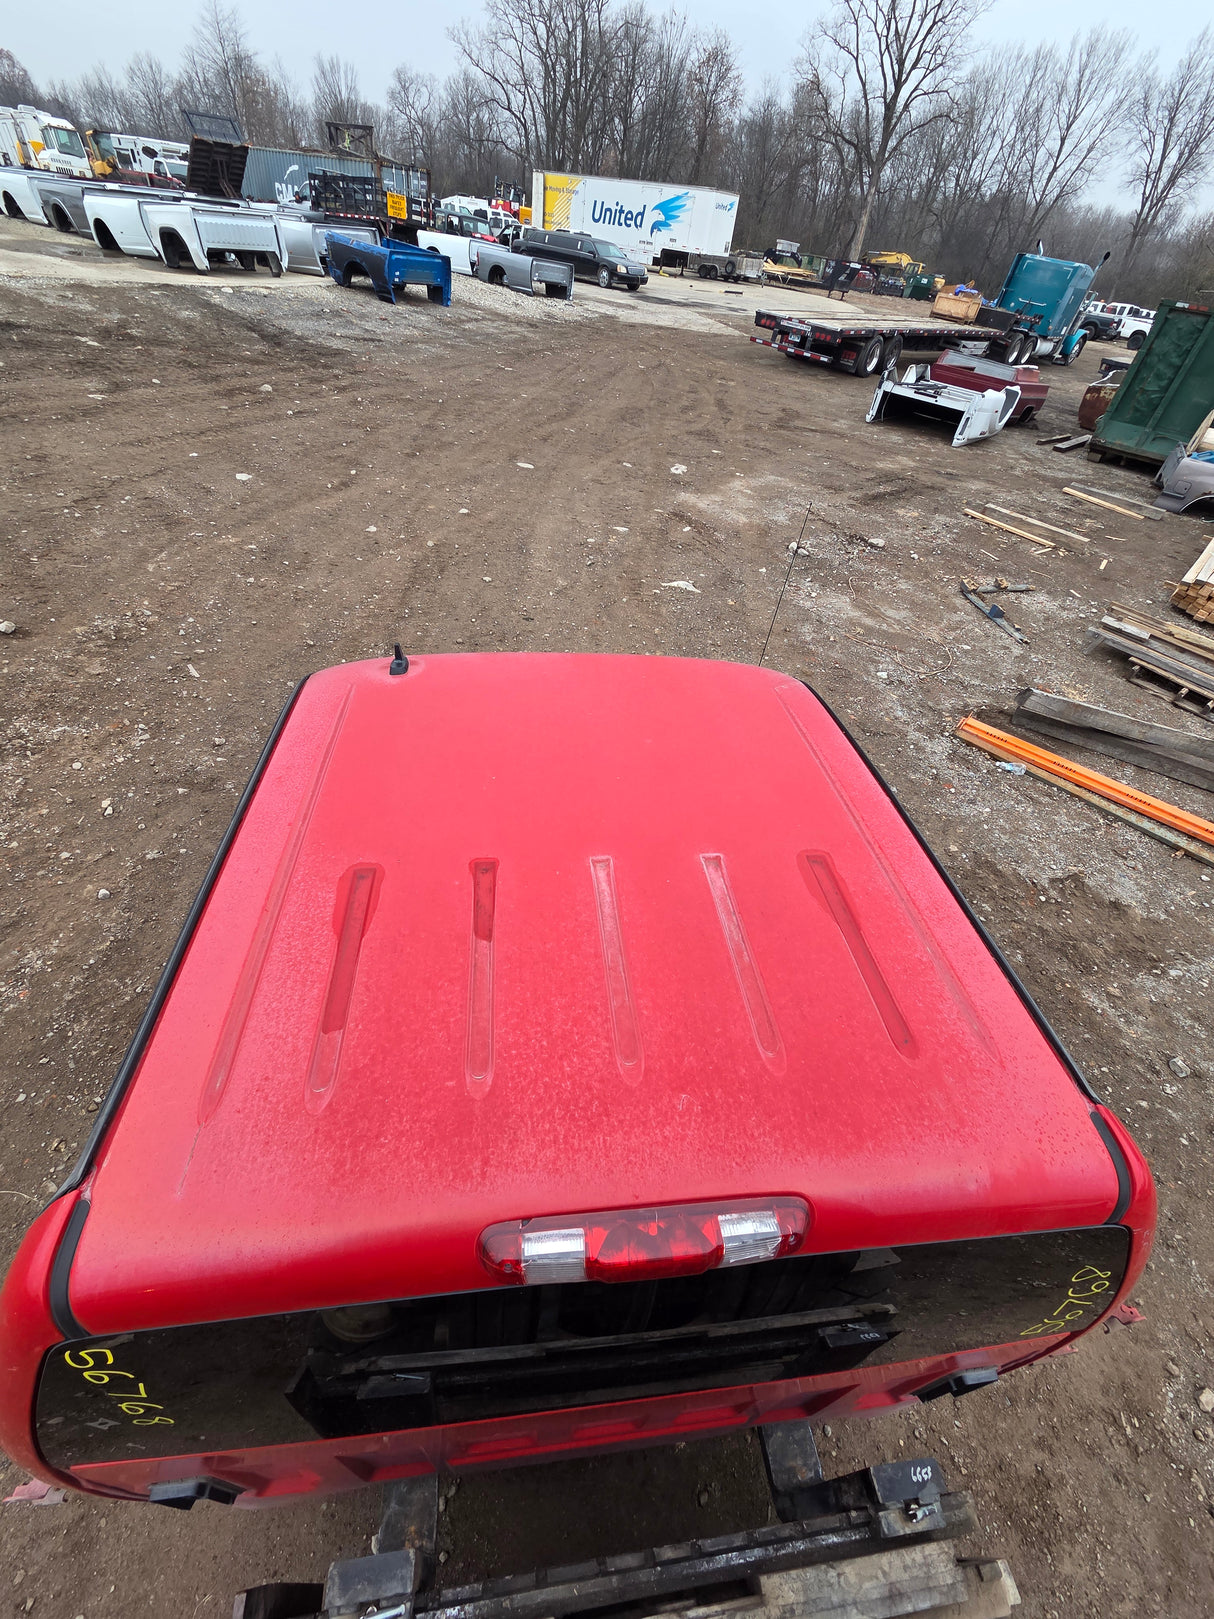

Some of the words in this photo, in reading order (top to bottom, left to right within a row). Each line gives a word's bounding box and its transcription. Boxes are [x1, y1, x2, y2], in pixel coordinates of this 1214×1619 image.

[592, 200, 646, 229] United
[715, 202, 728, 211] United
[1020, 1265, 1111, 1335] 56768
[64, 1349, 175, 1425] 56768
